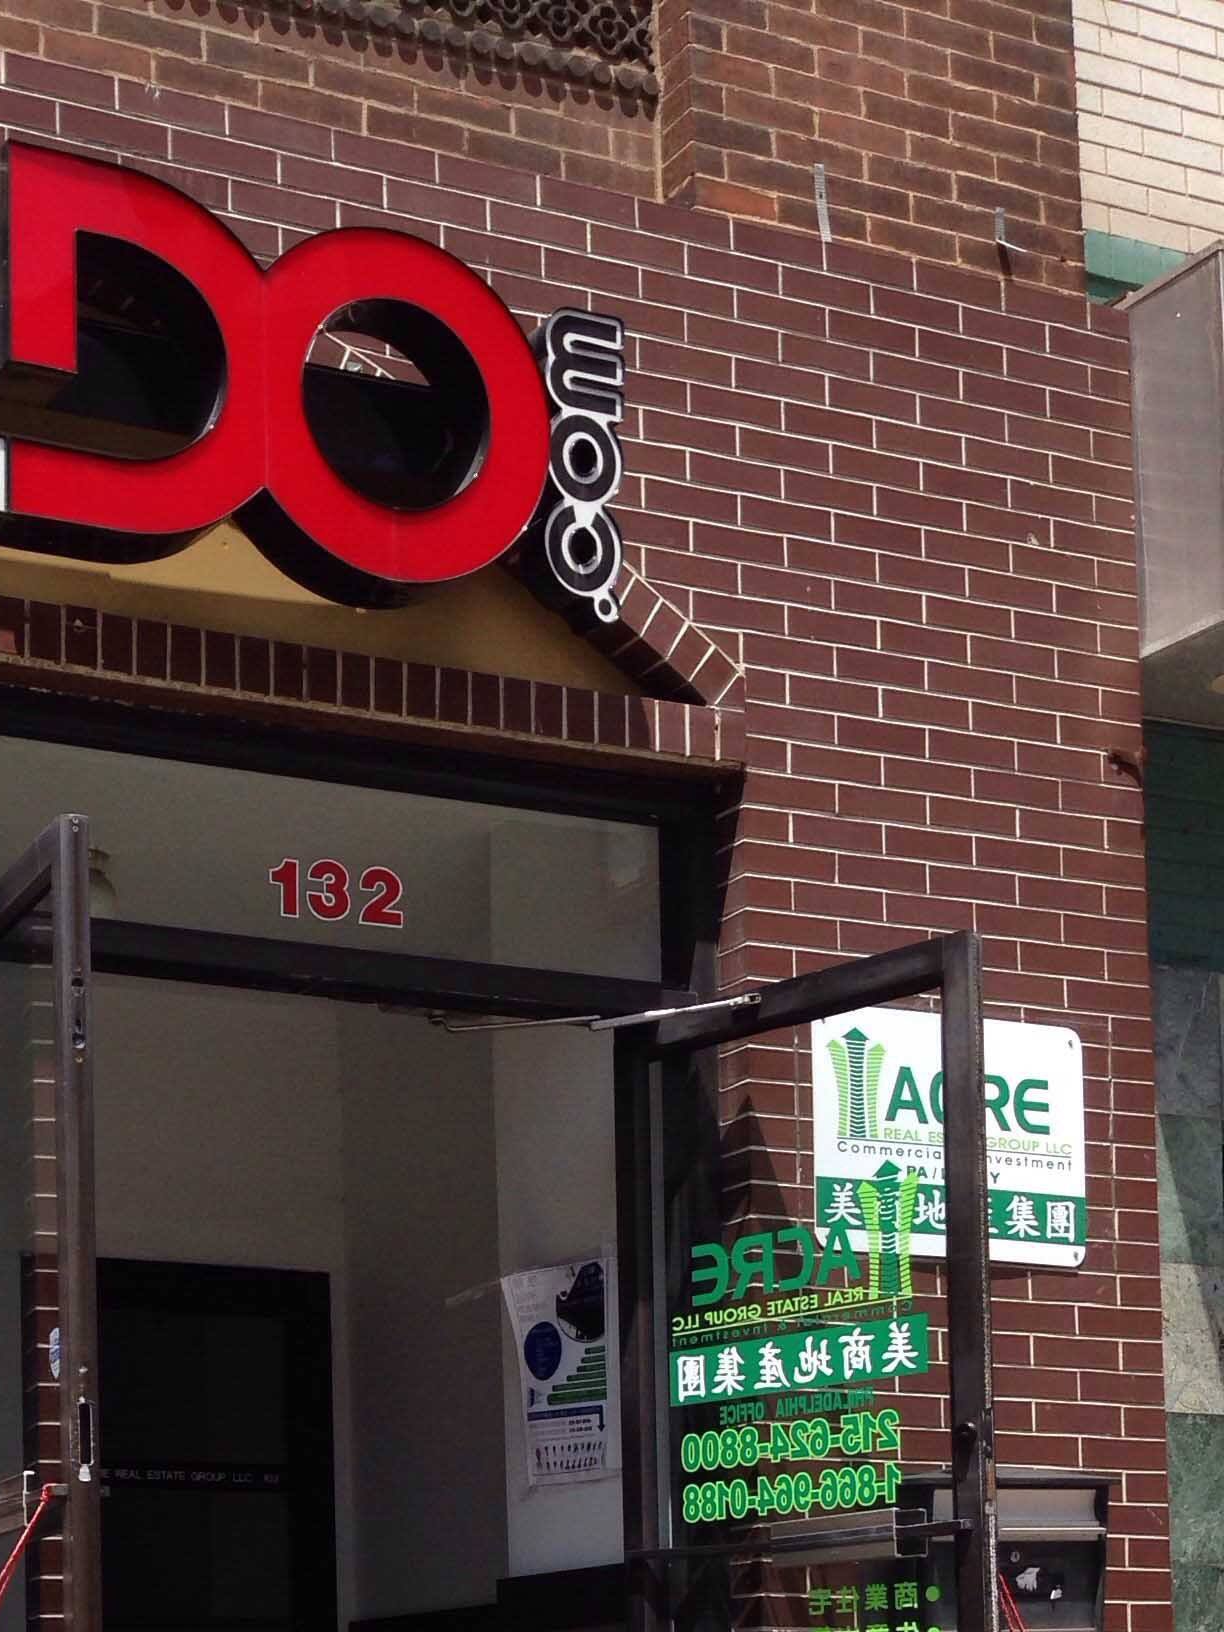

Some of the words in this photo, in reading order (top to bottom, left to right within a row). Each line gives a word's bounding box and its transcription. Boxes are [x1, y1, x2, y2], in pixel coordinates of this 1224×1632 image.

[269, 857, 404, 928] 132
[884, 1066, 1050, 1135] ARE
[837, 1140, 942, 1160] Commercia
[984, 1153, 1073, 1172] nvestment
[883, 1127, 922, 1142] REAL
[984, 1138, 1040, 1153] GROUP
[1045, 1142, 1072, 1155] LLC
[825, 1184, 1076, 1243] 美地集團
